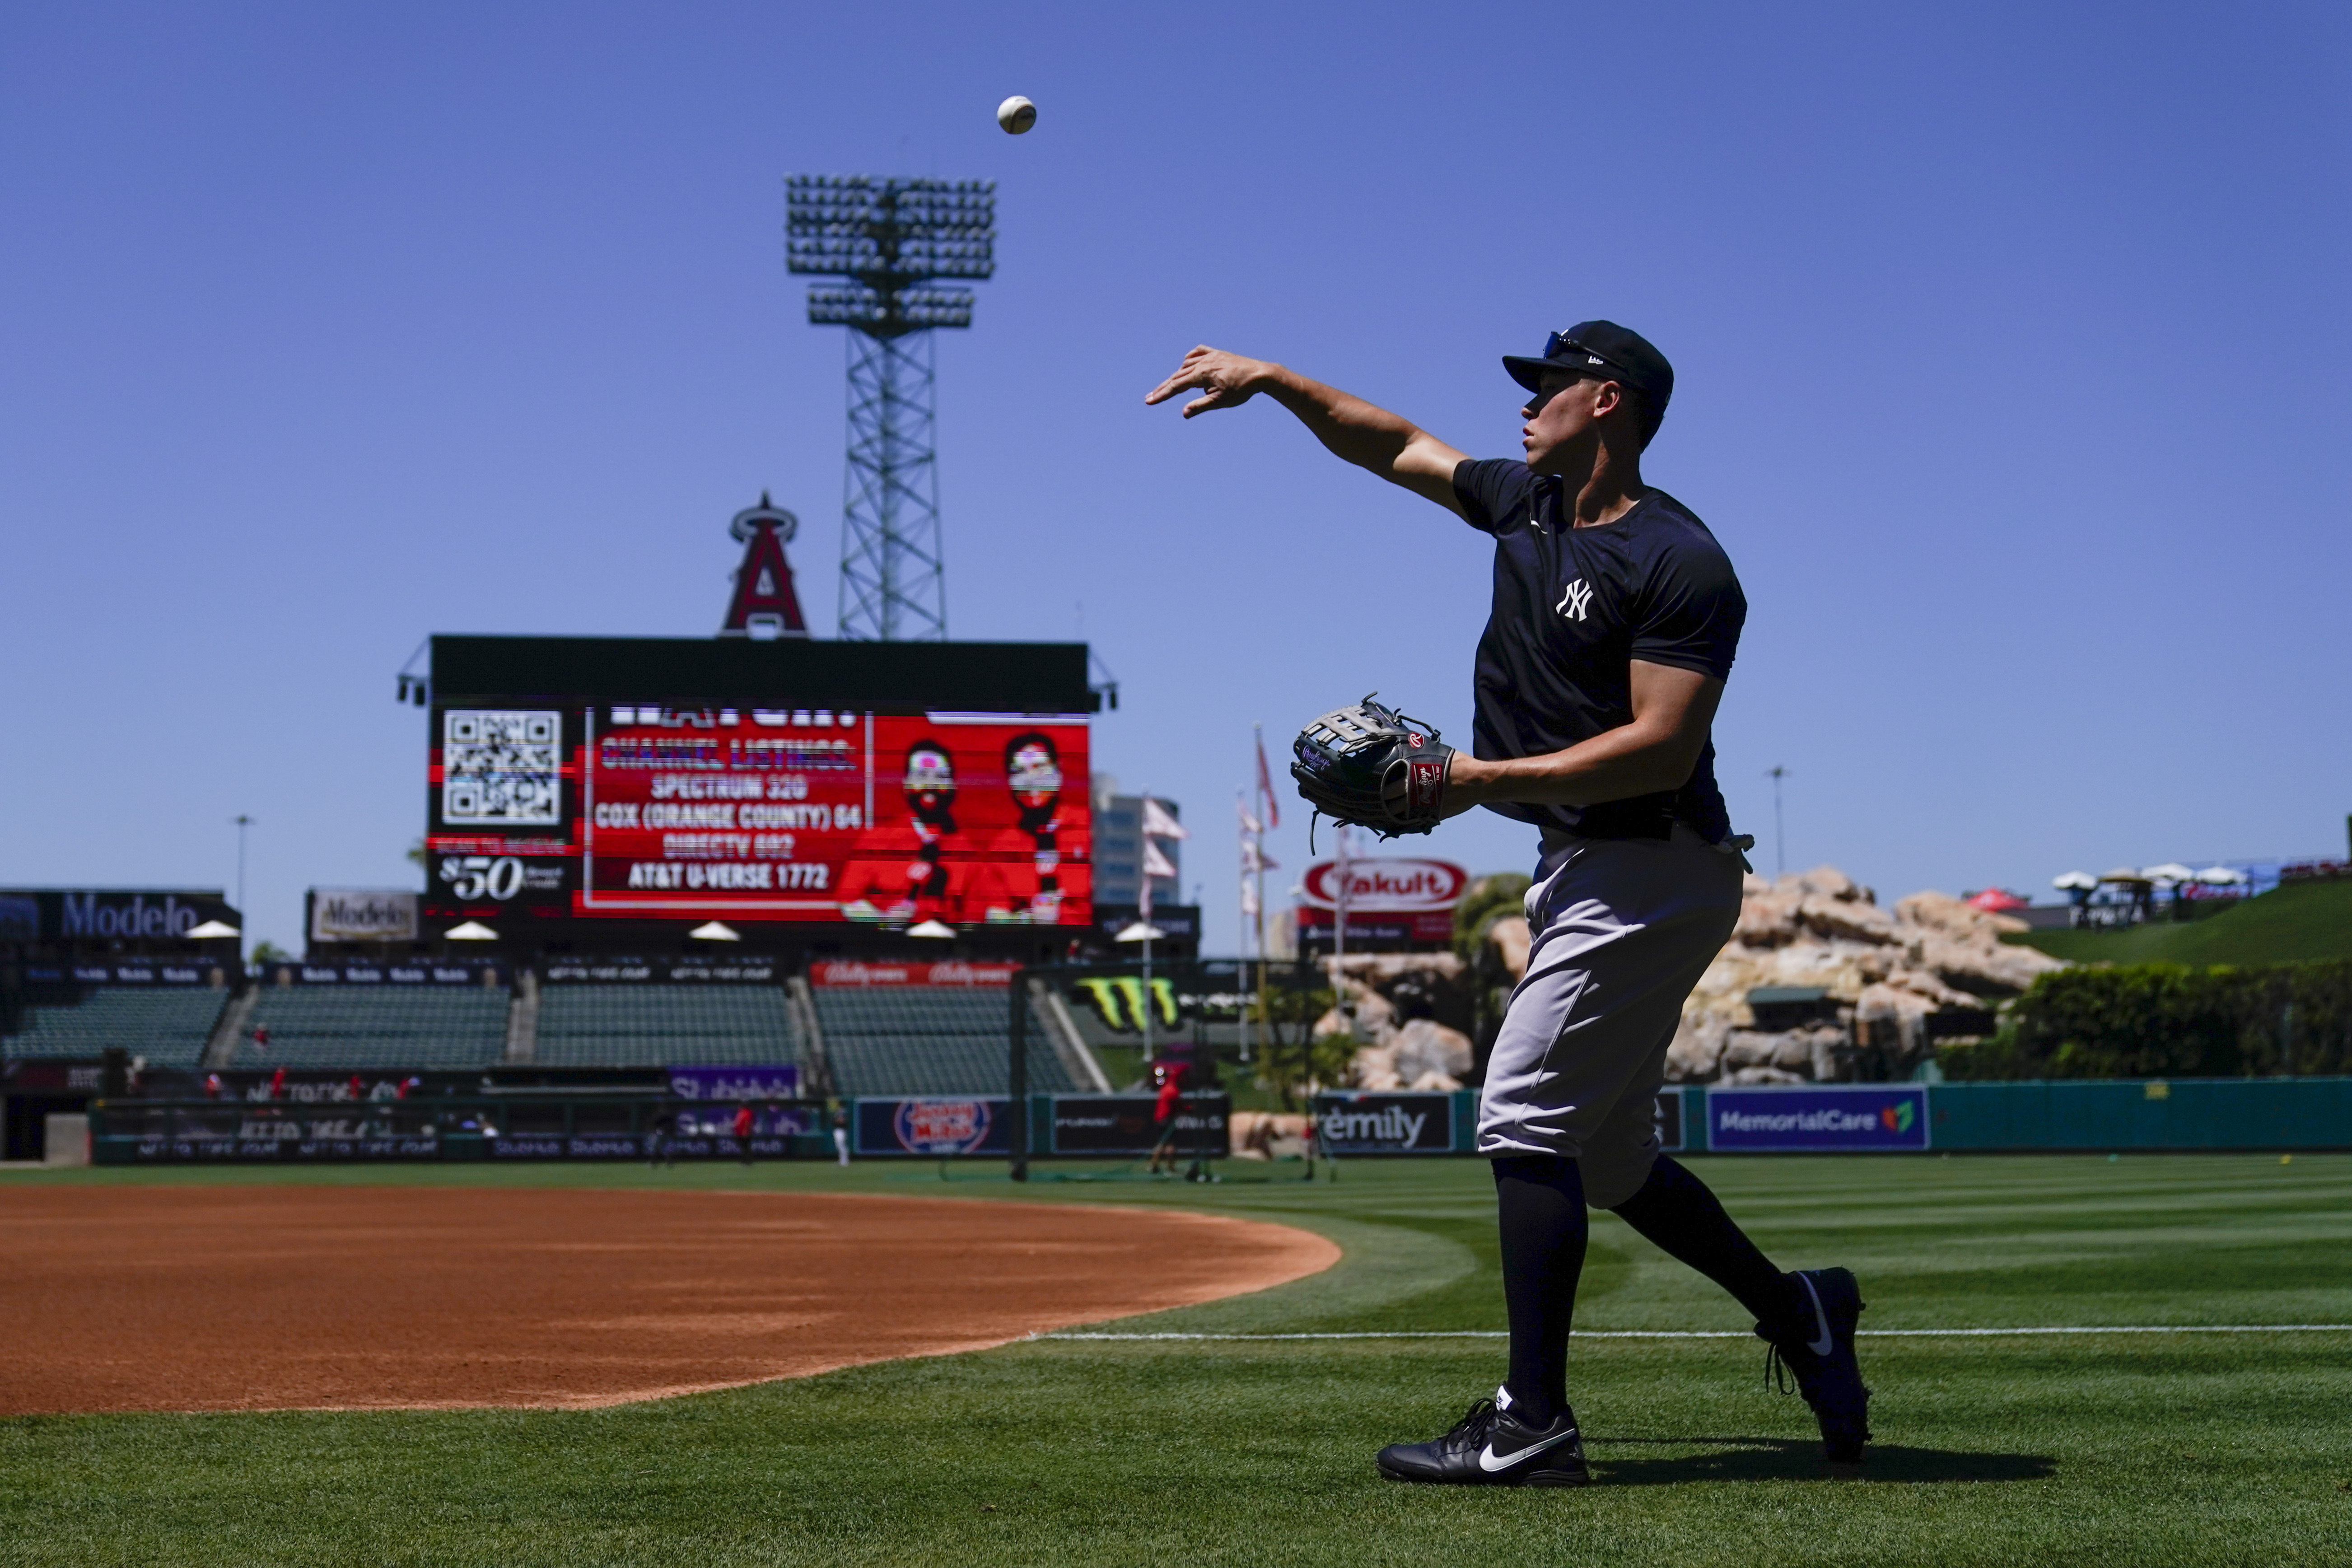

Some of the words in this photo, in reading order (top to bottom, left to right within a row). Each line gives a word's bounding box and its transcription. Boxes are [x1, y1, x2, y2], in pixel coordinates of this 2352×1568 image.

[595, 802, 640, 829] COX
[777, 863, 829, 889] 1772
[63, 893, 198, 938] Modelo
[1720, 1109, 1877, 1131] MemorialCare
